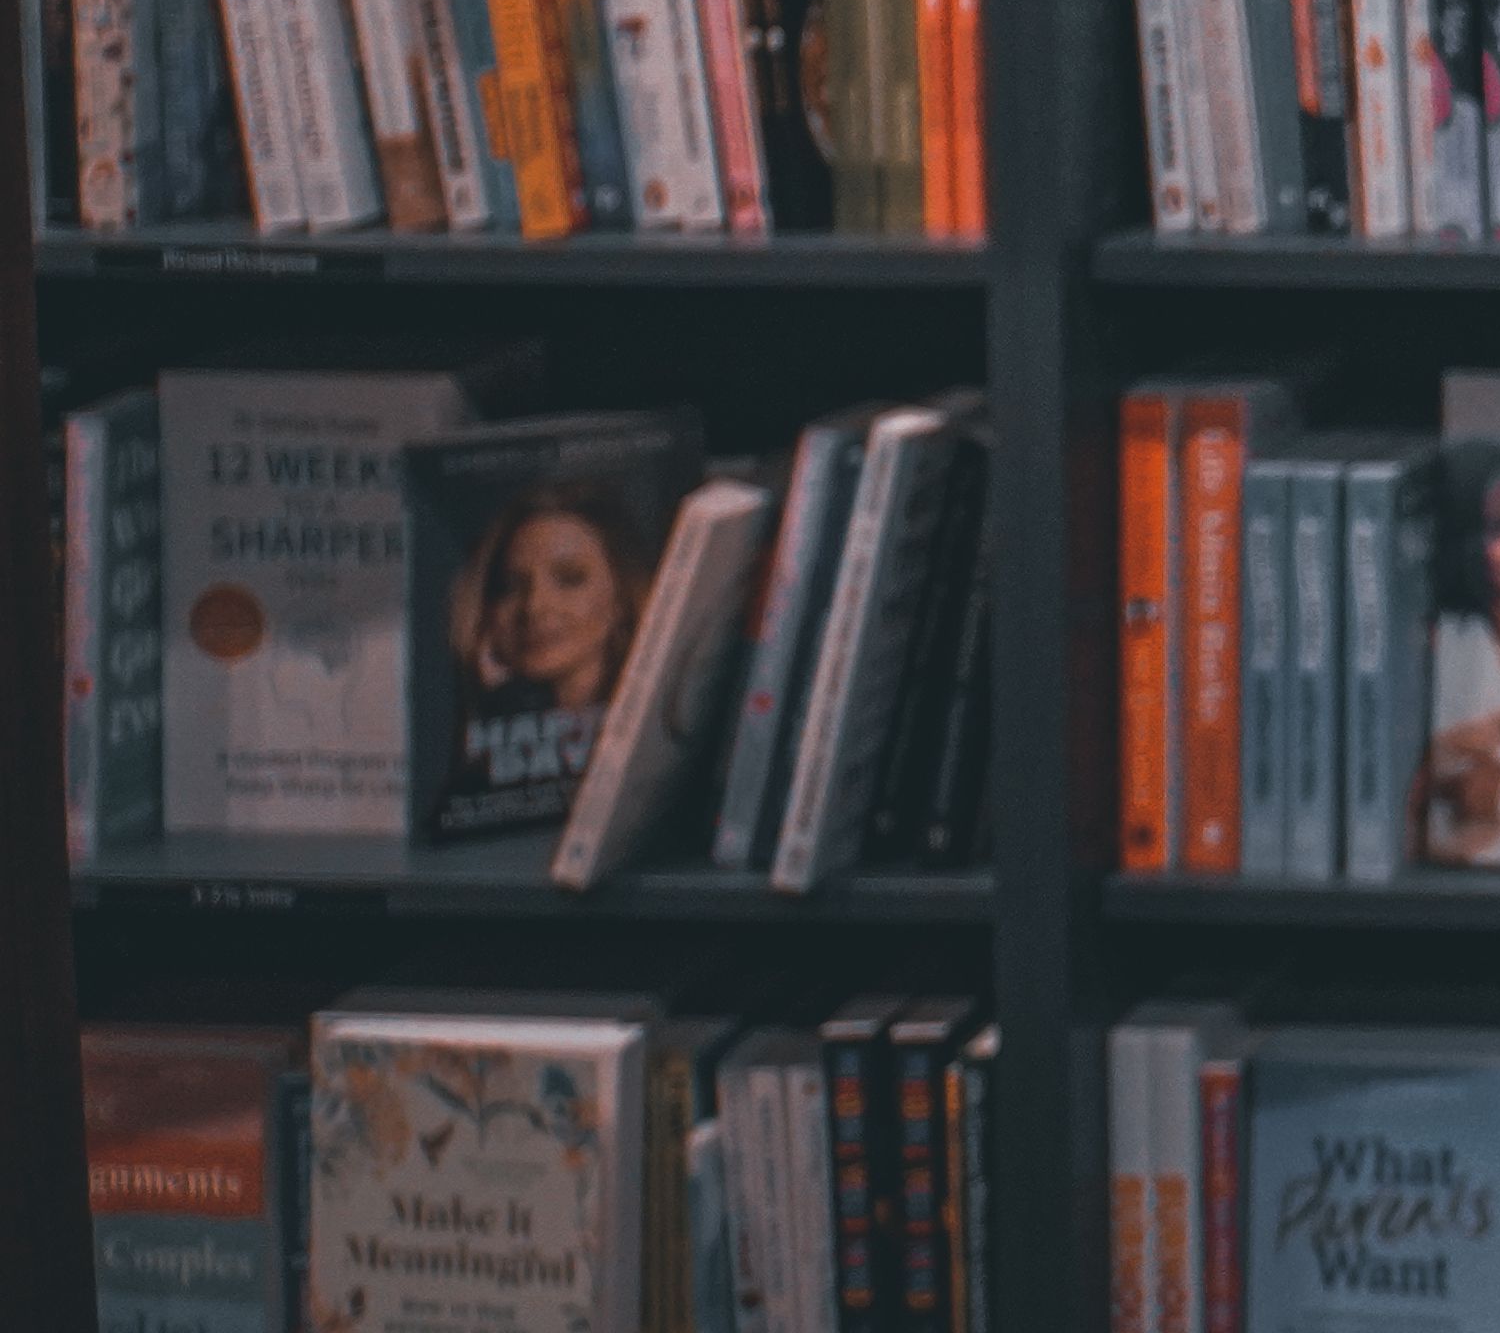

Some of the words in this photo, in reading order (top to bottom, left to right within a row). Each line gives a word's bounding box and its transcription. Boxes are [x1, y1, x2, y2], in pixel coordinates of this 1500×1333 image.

[206, 445, 258, 488] 12
[1312, 1139, 1456, 1191] What
[388, 1195, 492, 1234] Make
[103, 1239, 257, 1281] Couples
[343, 1233, 577, 1286] Meaningful
[1313, 1244, 1450, 1300] Want
